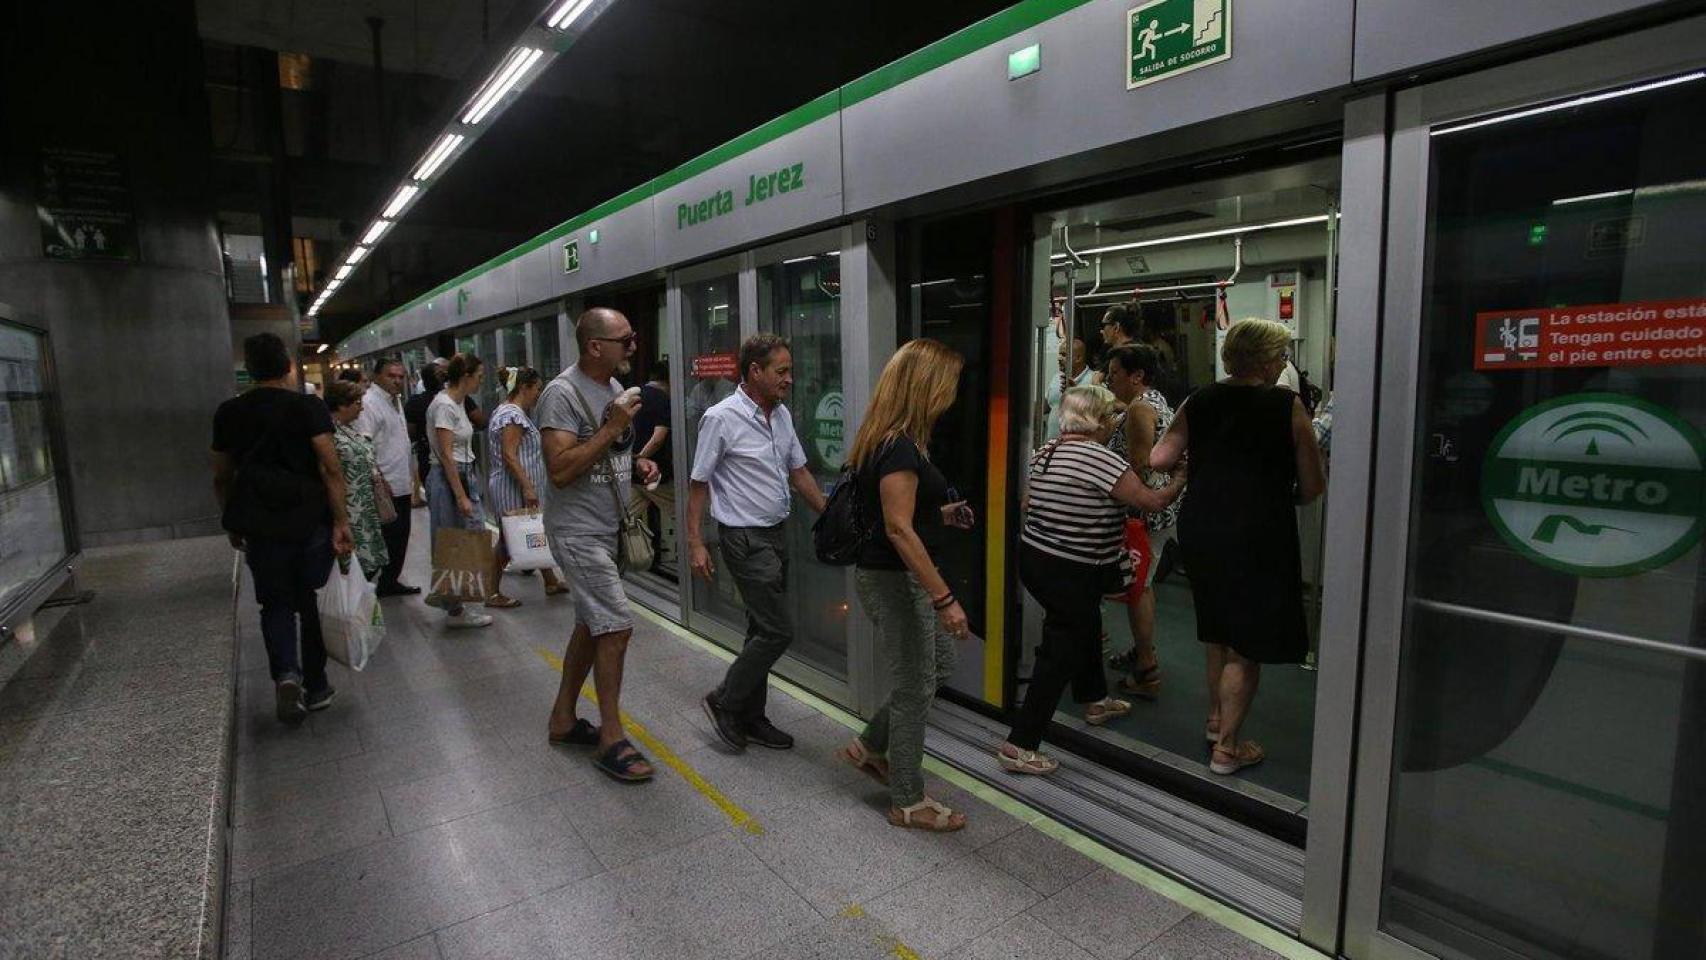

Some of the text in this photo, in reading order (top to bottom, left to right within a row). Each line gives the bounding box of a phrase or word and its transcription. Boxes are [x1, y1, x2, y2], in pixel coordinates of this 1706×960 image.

[1139, 44, 1217, 75] SALIDA DE SOCORRO
[678, 163, 803, 230] Puerta Jerez
[1550, 303, 1706, 325] La estación está
[1550, 326, 1703, 347] Tengan cuidado
[1548, 351, 1565, 363] el
[1570, 349, 1598, 365] pie
[1601, 347, 1653, 362] entre
[1517, 467, 1670, 506] Metro
